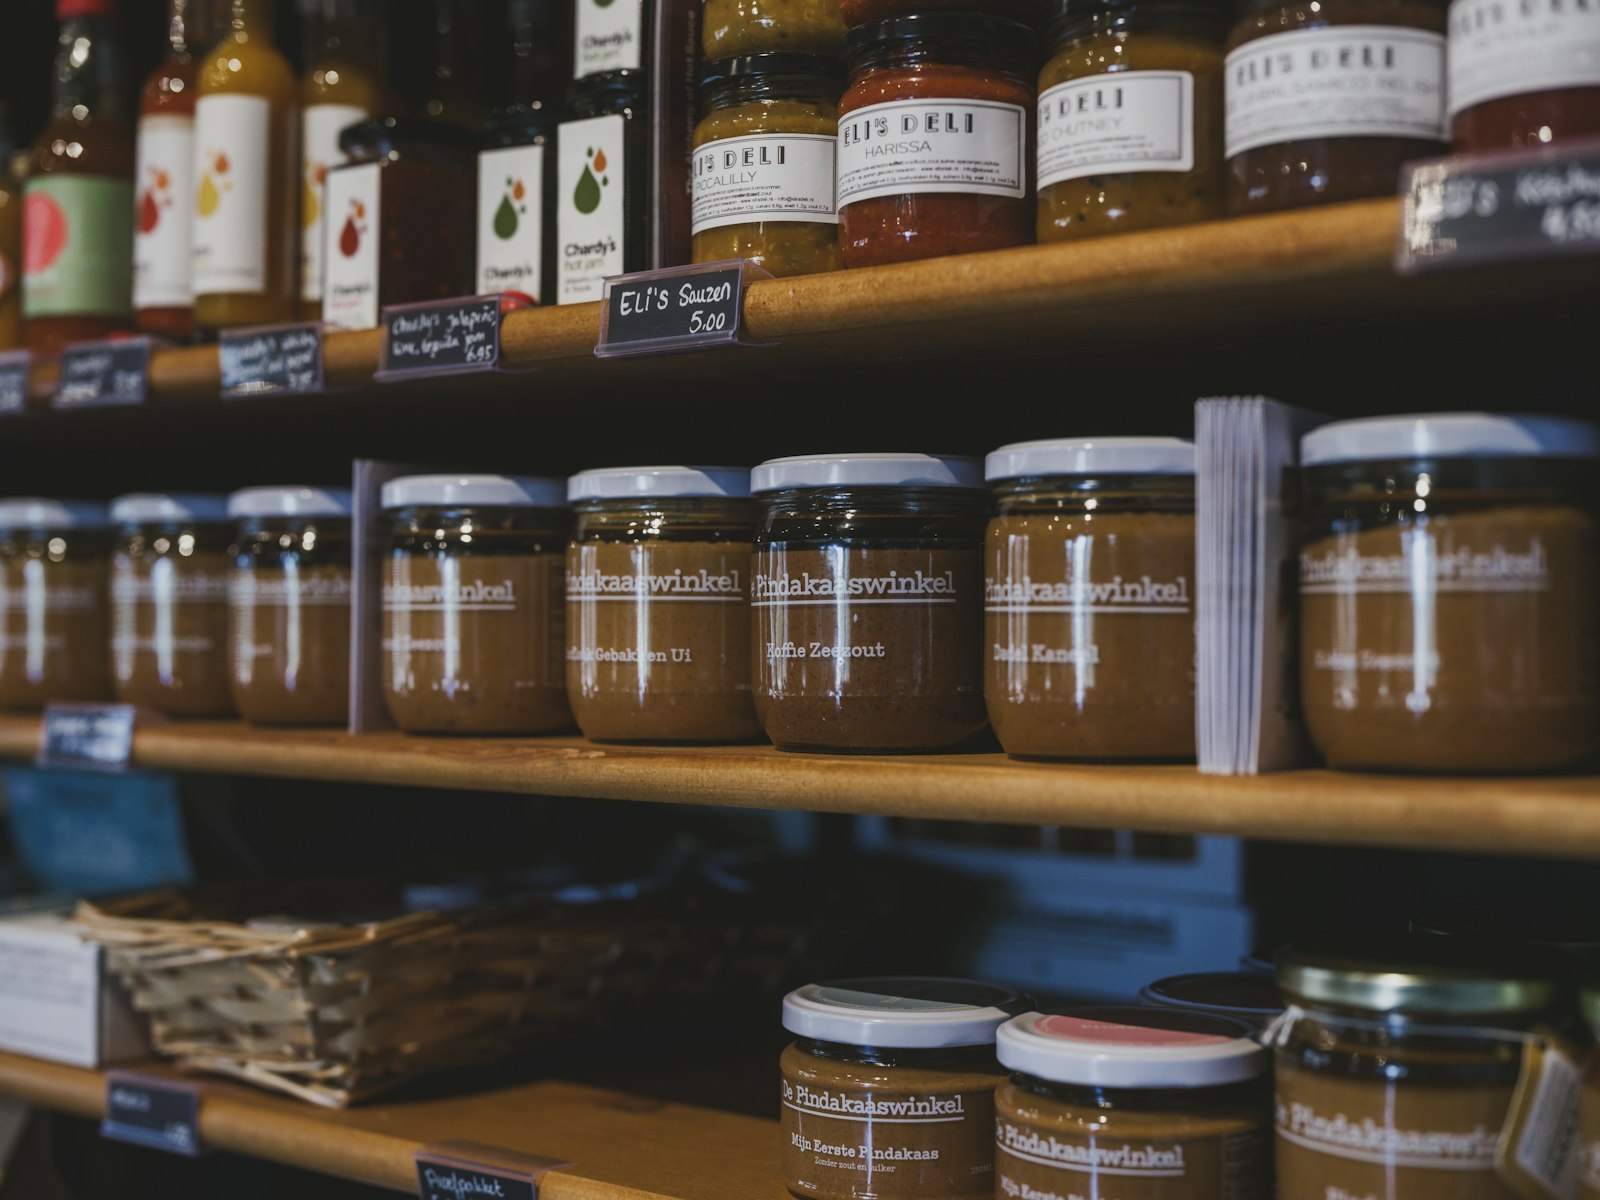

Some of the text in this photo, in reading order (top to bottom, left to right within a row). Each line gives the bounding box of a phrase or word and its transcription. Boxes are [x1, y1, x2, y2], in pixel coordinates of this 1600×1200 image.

[1310, 45, 1394, 69] DELI
[1058, 88, 1123, 118] DELI
[843, 112, 974, 148] ELI'S DELI
[1051, 117, 1123, 141] CHUTNEY
[723, 145, 786, 170] DELI
[865, 140, 932, 159] HARISSA
[564, 236, 617, 257] Chardy's
[678, 282, 731, 307] Sauzen
[756, 570, 956, 598] Pindakaaswinkel
[670, 648, 693, 662] Ui
[766, 641, 886, 658] Koffie Zeezout
[783, 1078, 965, 1116] De Pindakaaswinkel
[791, 1132, 812, 1153] Mijn
[813, 1138, 856, 1158] Eerste
[814, 1156, 896, 1173] Zonder zout en uiker
